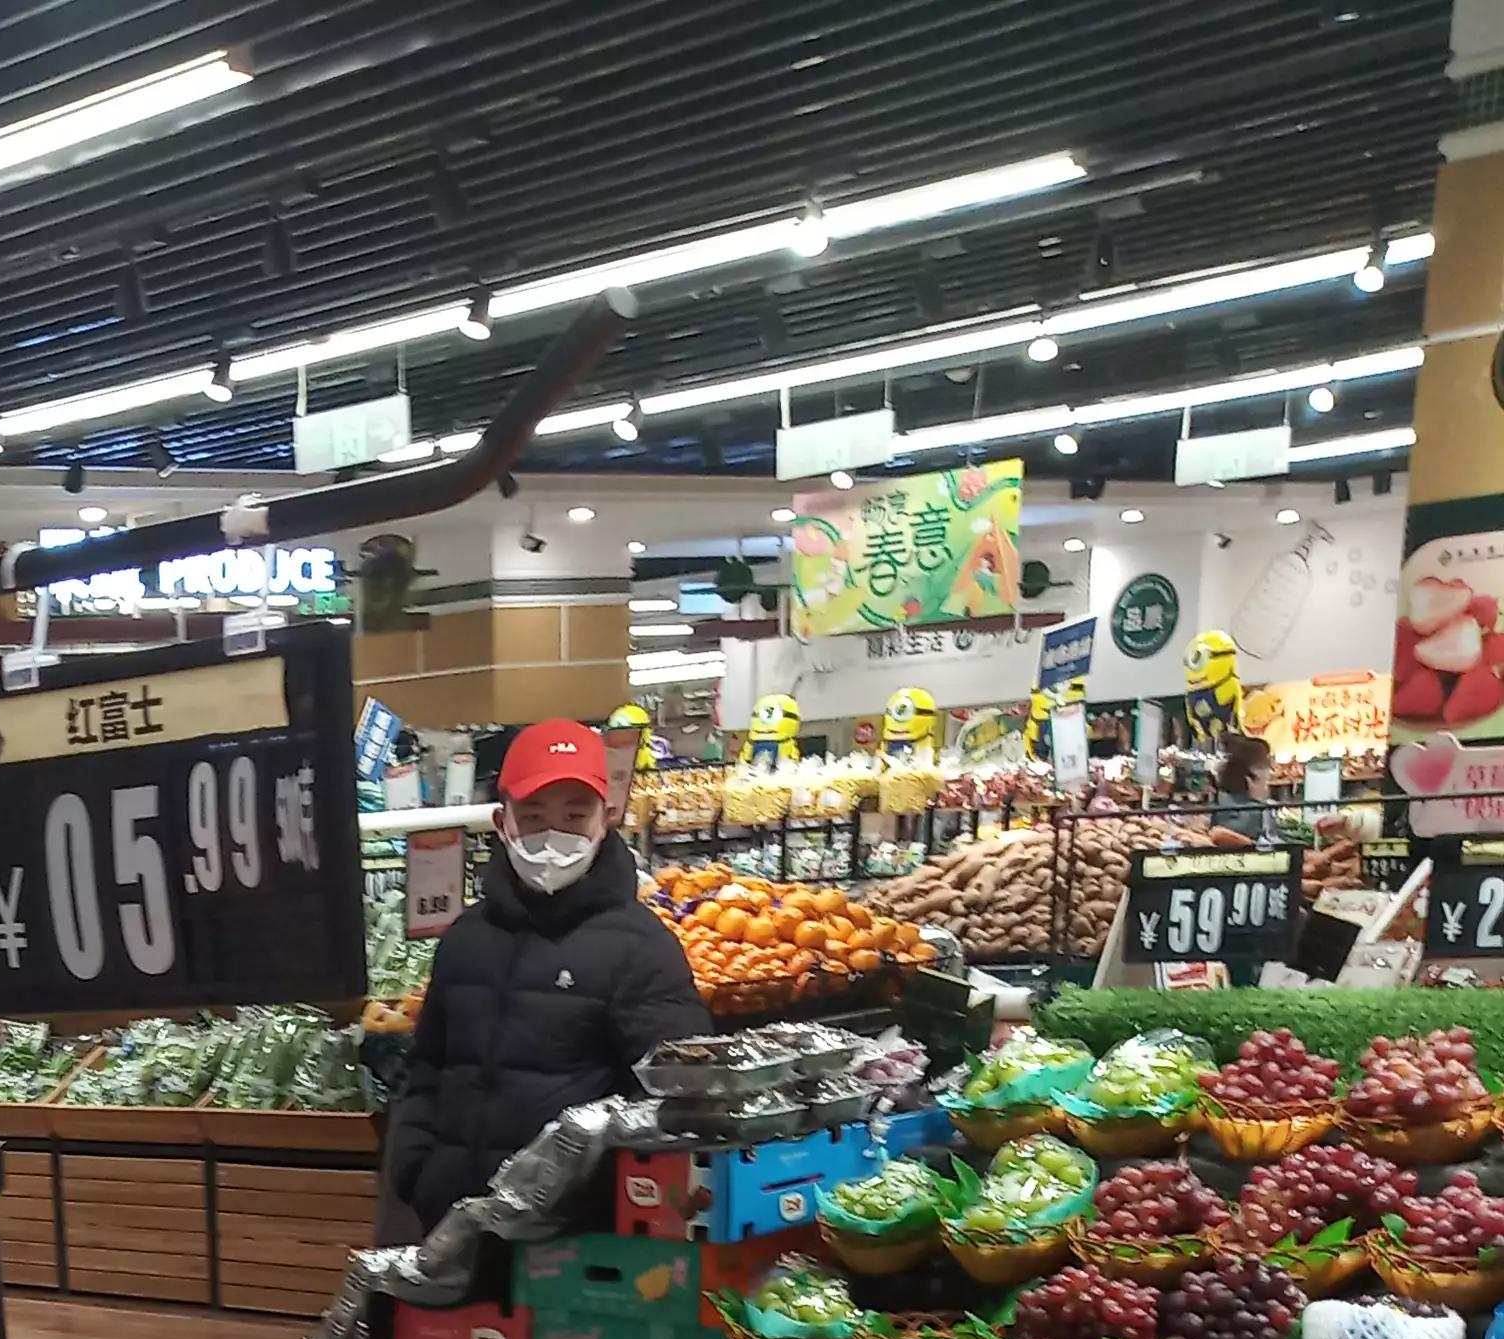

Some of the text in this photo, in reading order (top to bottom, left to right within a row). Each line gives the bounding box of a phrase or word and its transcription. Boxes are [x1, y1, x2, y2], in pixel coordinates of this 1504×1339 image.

[158, 548, 336, 594] PRODUCE
[66, 685, 164, 746] 红富士
